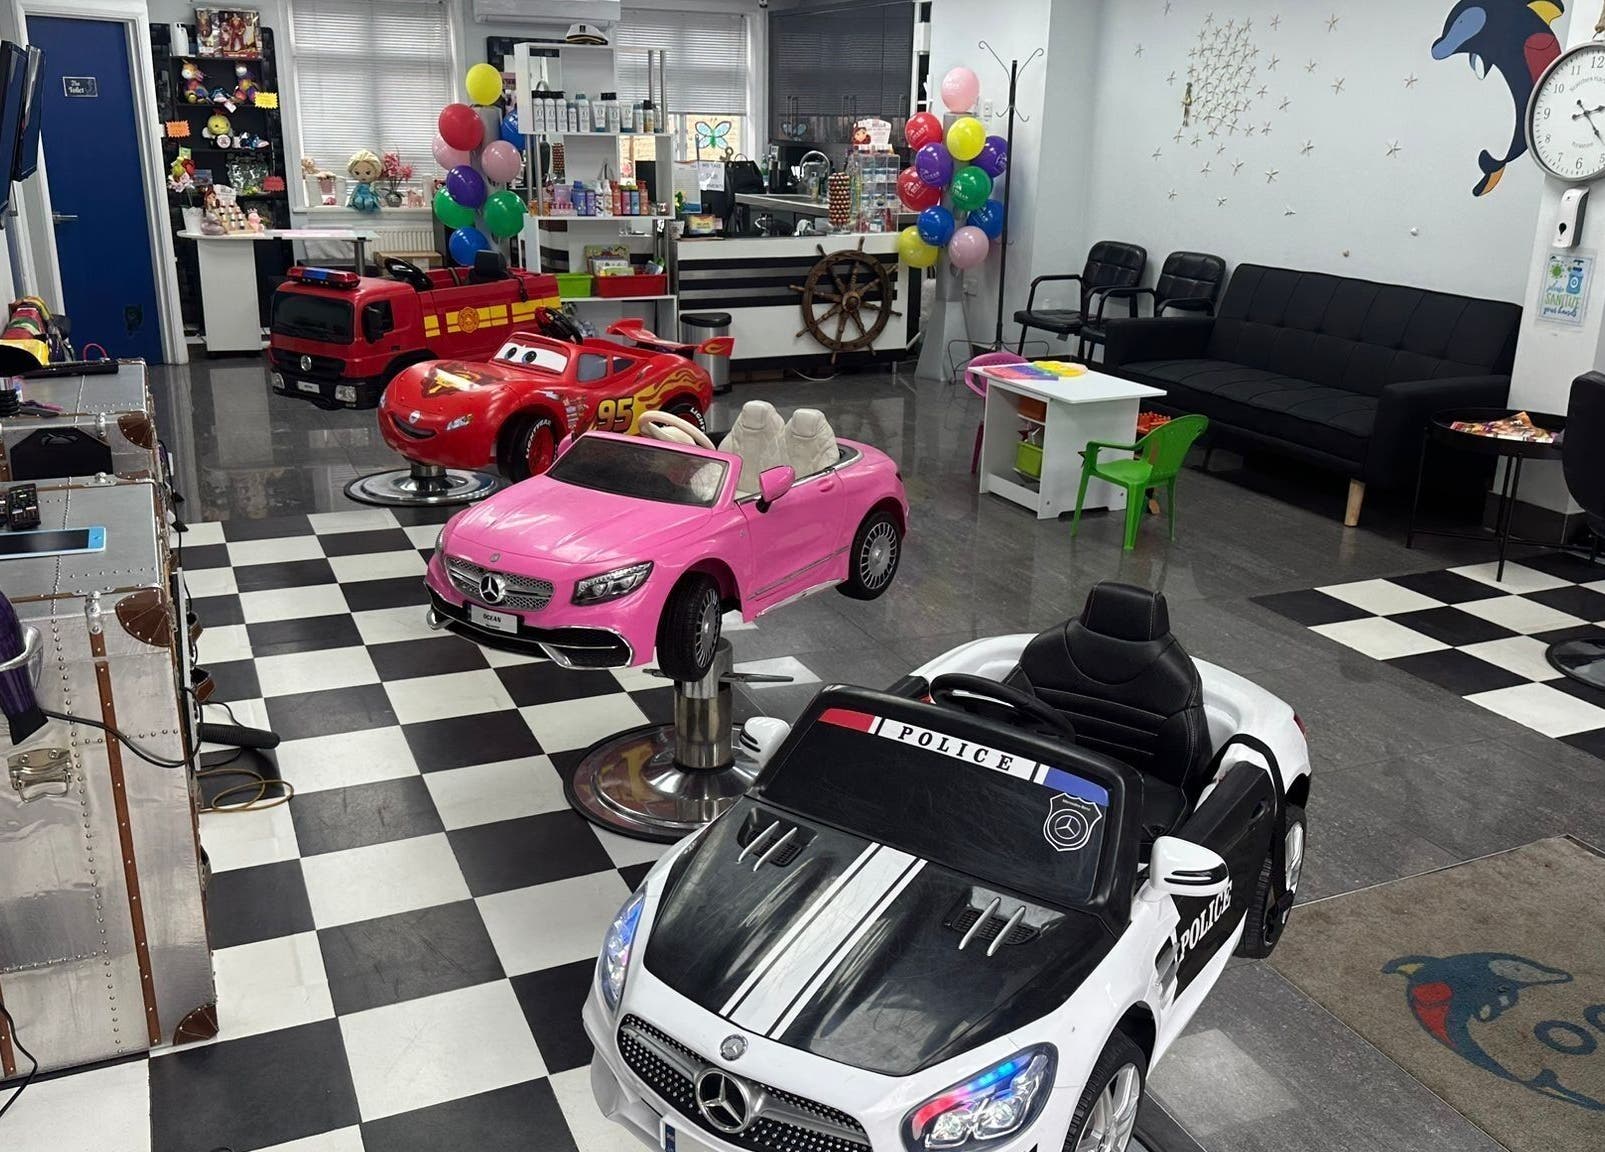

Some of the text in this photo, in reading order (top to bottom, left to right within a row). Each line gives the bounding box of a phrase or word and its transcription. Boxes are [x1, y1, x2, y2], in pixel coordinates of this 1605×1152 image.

[1591, 55, 1605, 69] 12
[1571, 65, 1580, 76] 11
[1553, 83, 1565, 94] 10
[1543, 107, 1551, 120] 9
[1544, 133, 1552, 144] 8
[1557, 152, 1564, 162] 7
[1575, 156, 1583, 170] 6
[598, 397, 634, 432] 95
[898, 725, 1013, 771] POLICE
[1179, 880, 1232, 963] POLICE
